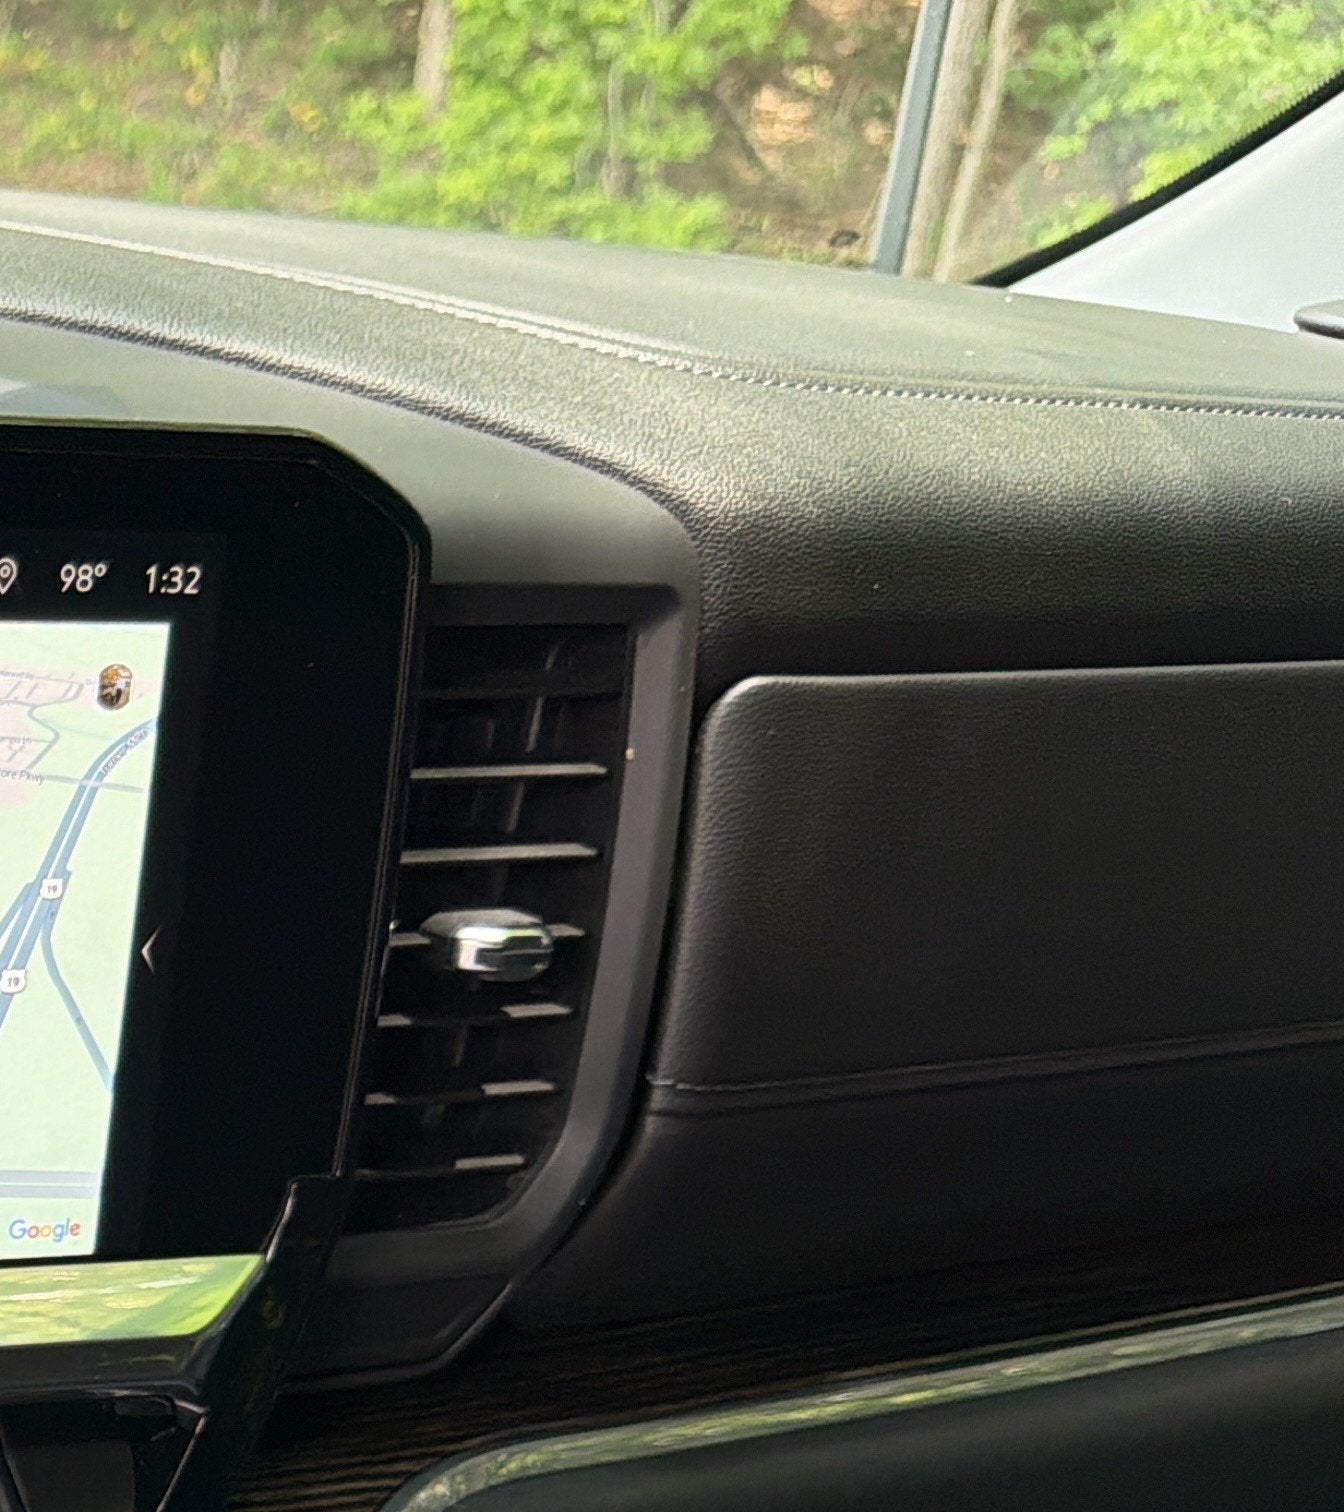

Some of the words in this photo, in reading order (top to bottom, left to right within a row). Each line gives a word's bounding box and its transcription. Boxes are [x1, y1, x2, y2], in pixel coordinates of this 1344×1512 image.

[145, 564, 202, 594] 1:32
[19, 769, 45, 784] Pkwy
[7, 977, 20, 987] 19
[9, 1218, 81, 1244] Google
